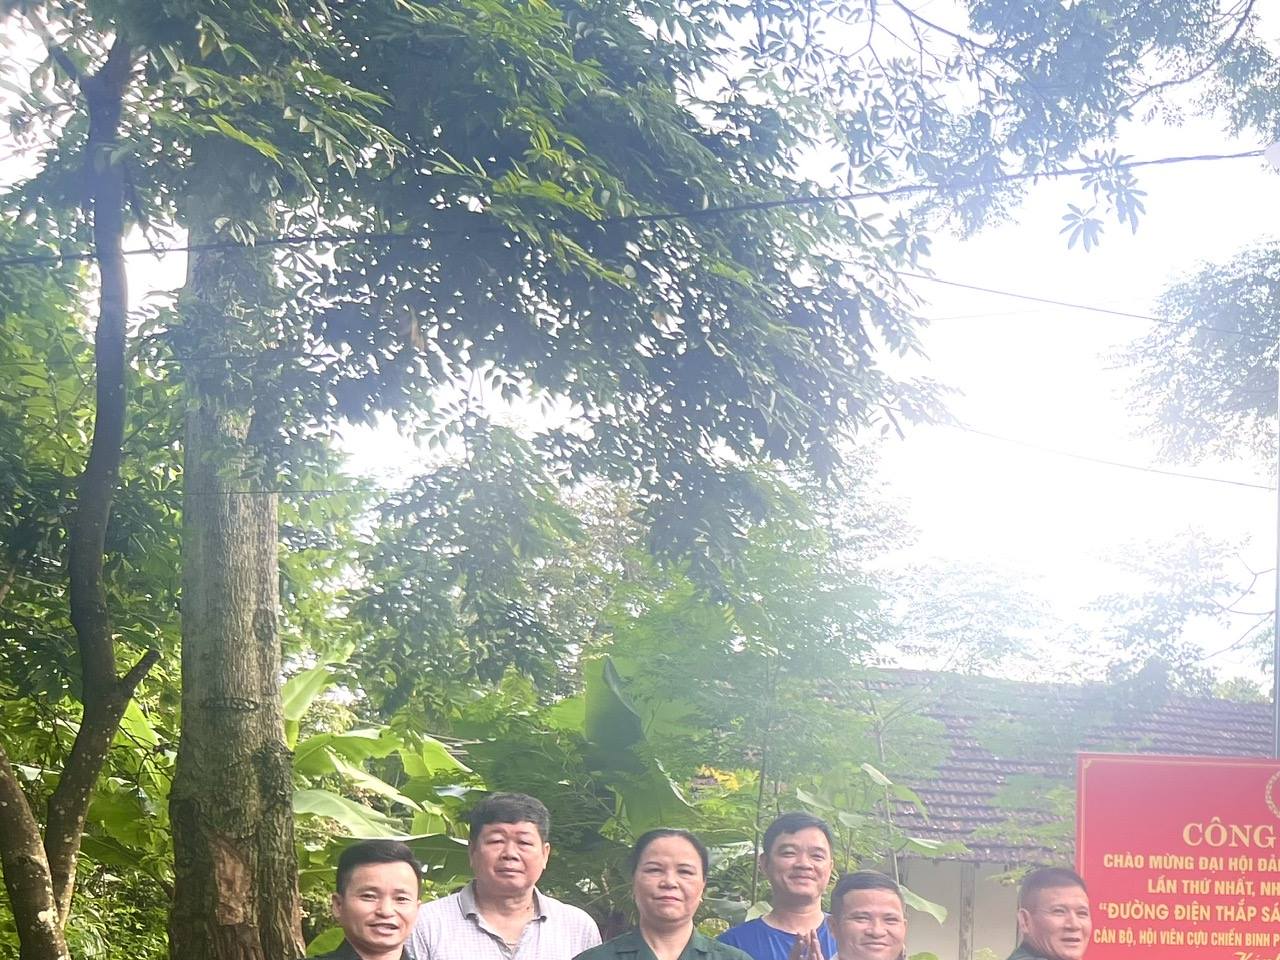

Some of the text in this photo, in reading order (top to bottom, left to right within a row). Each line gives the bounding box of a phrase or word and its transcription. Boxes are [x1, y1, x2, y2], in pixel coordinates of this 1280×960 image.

[1182, 816, 1276, 848] CÔNG
[1103, 852, 1144, 868] CHÀO
[1149, 853, 1194, 870] MỪNG
[1199, 857, 1223, 873] ĐẠI
[1228, 855, 1253, 874] HỘI
[1182, 878, 1211, 894] THỨ
[1174, 901, 1211, 925] ĐIỆN
[1215, 898, 1257, 921] THẮP
[1139, 928, 1157, 947] HỘI
[1160, 928, 1184, 945] VIÊN
[1187, 931, 1208, 948] CỰU
[1210, 928, 1242, 946] CHIẾN
[1245, 932, 1270, 947] BINH
